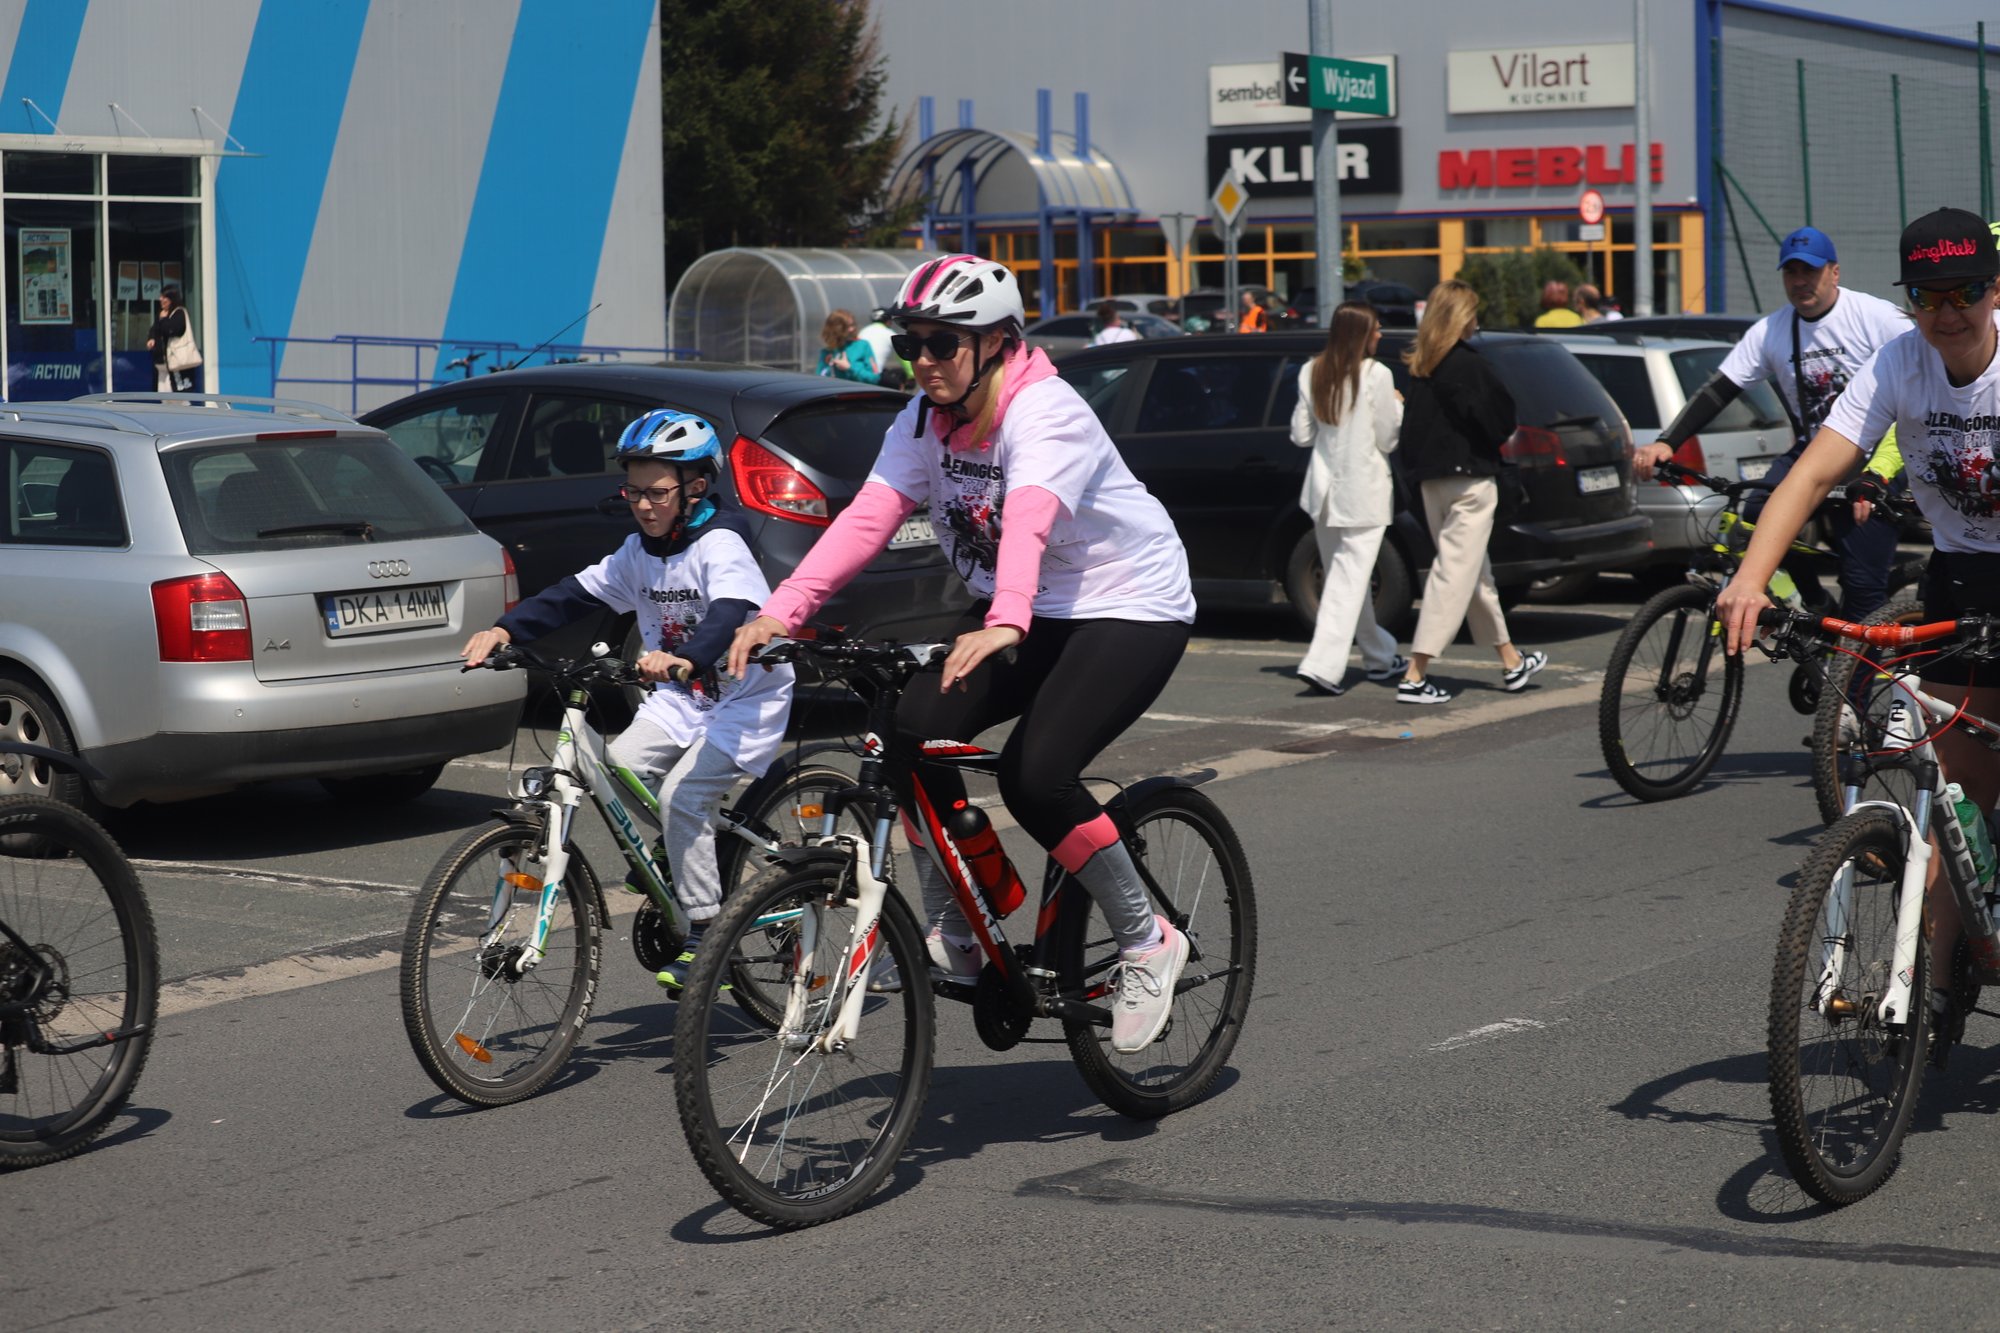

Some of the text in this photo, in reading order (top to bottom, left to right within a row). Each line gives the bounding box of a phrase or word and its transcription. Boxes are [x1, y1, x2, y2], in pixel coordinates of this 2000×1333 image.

[1322, 67, 1376, 102] Wyjazd
[1491, 53, 1590, 88] Vilart
[1510, 91, 1587, 104] KUCHNIE
[34, 364, 81, 380] ACTION
[329, 617, 338, 625] PL
[341, 588, 442, 625] DKA 14MW
[263, 637, 292, 652] A4
[1936, 798, 1995, 937] FOCUS
[573, 903, 598, 1029] ACE OF PACE
